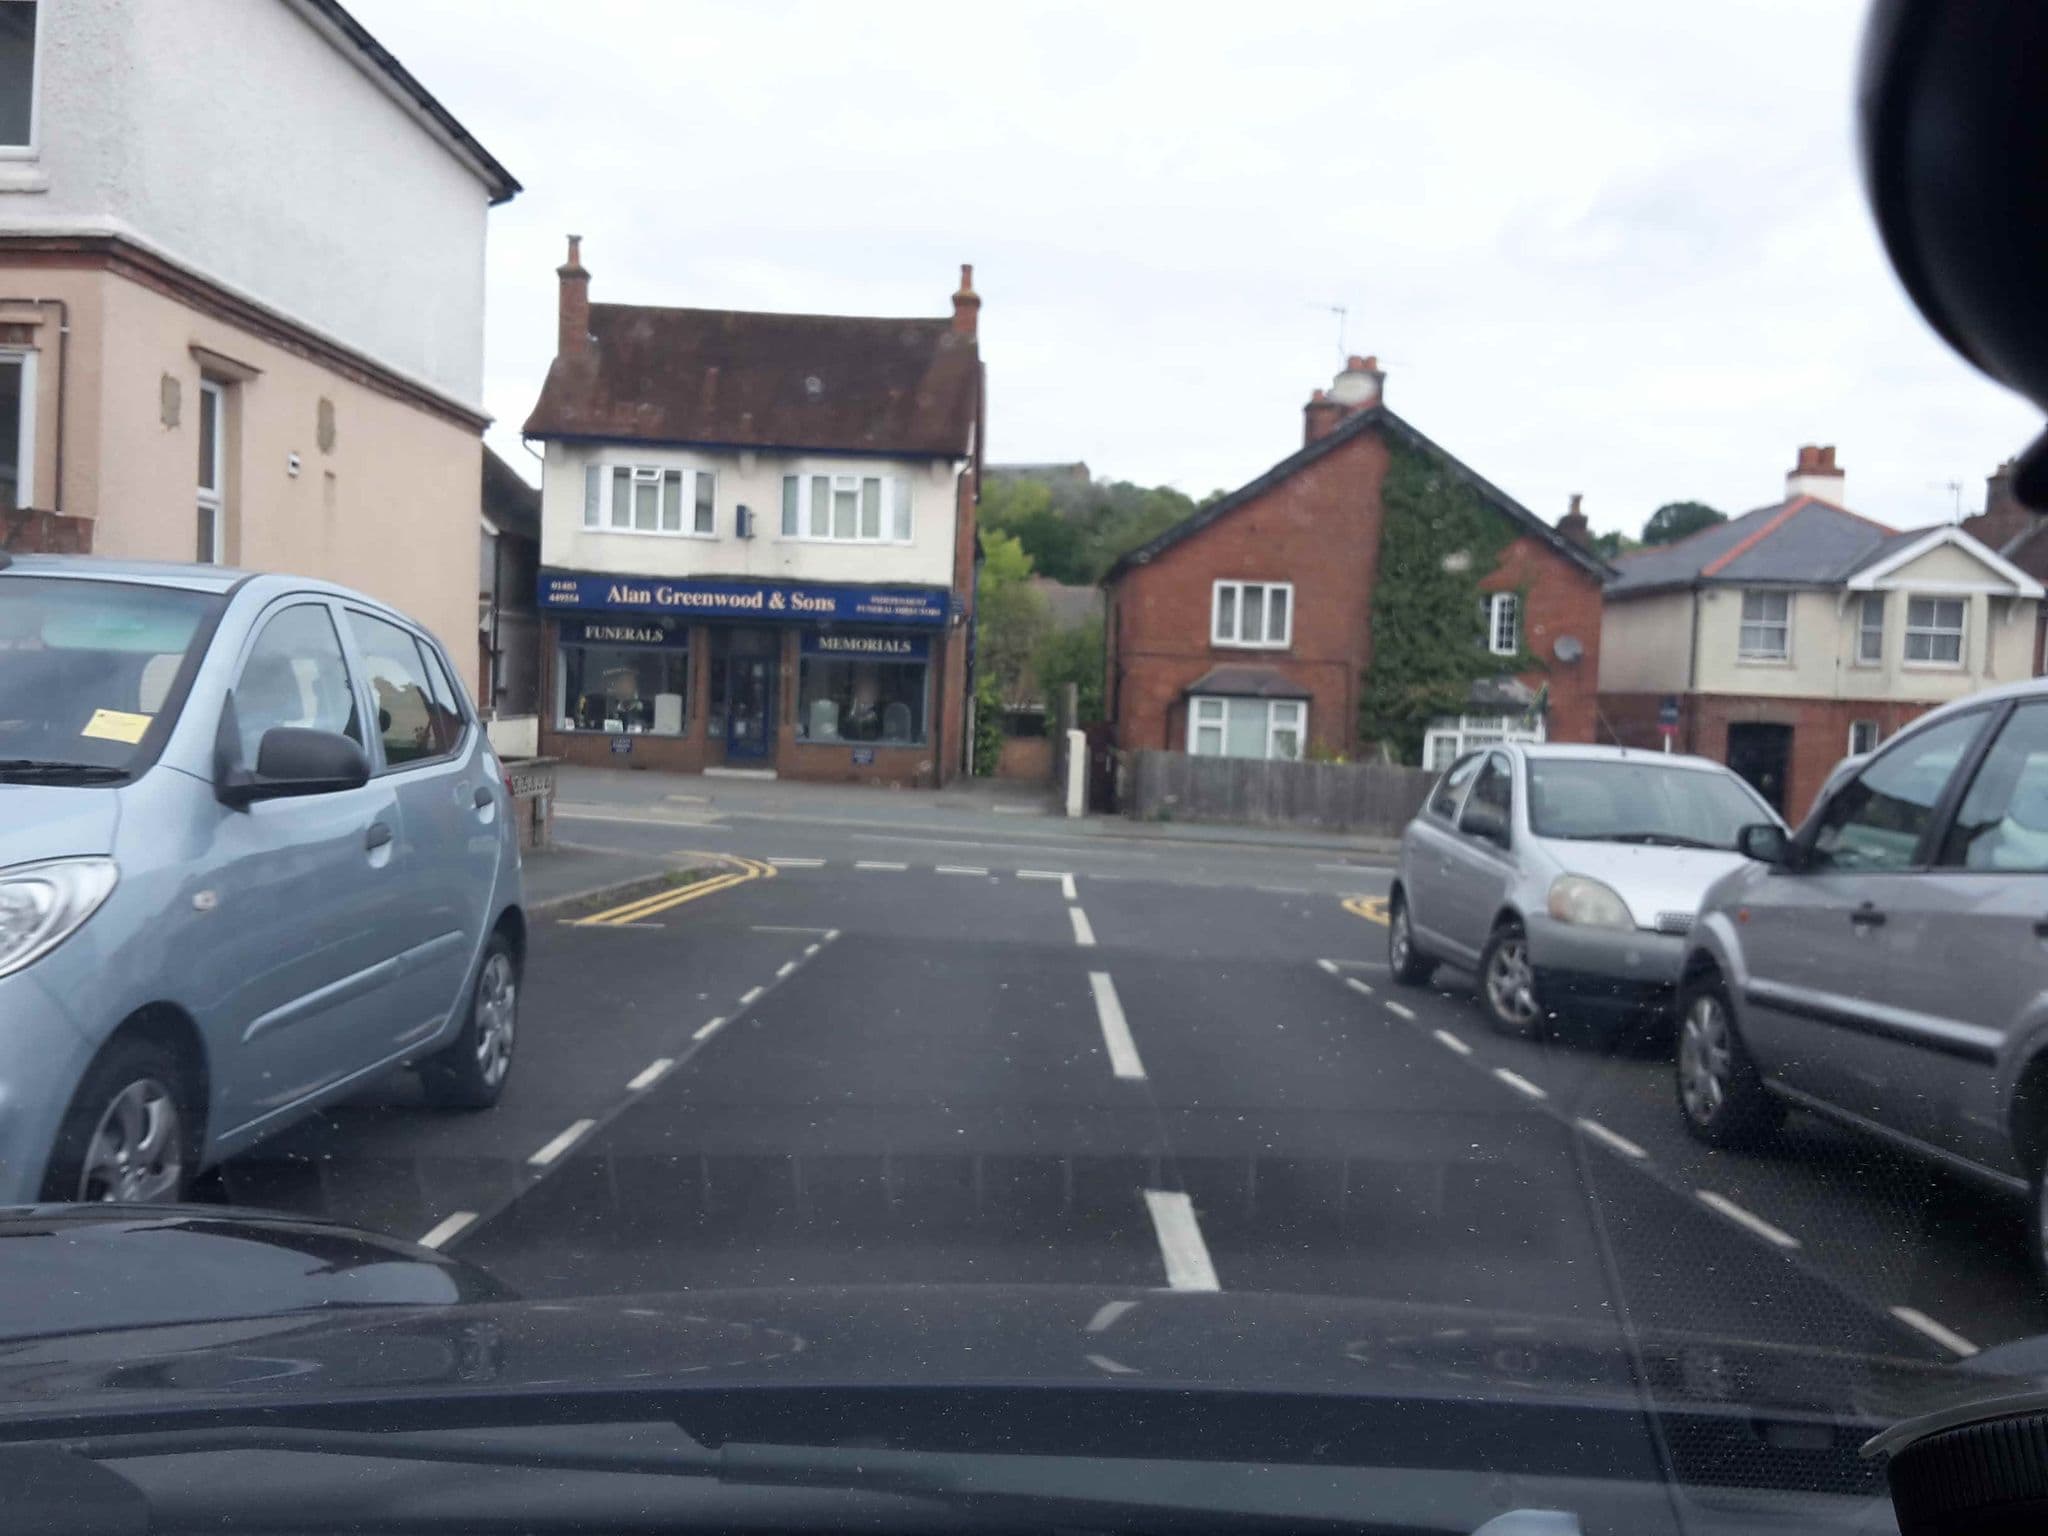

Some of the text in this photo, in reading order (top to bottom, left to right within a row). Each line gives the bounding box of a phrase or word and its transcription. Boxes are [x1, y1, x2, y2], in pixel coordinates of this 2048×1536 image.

[607, 584, 837, 611] Alan Greenwood & Sons
[585, 626, 664, 642] FUNERALS
[819, 637, 912, 653] MEMORIALS
